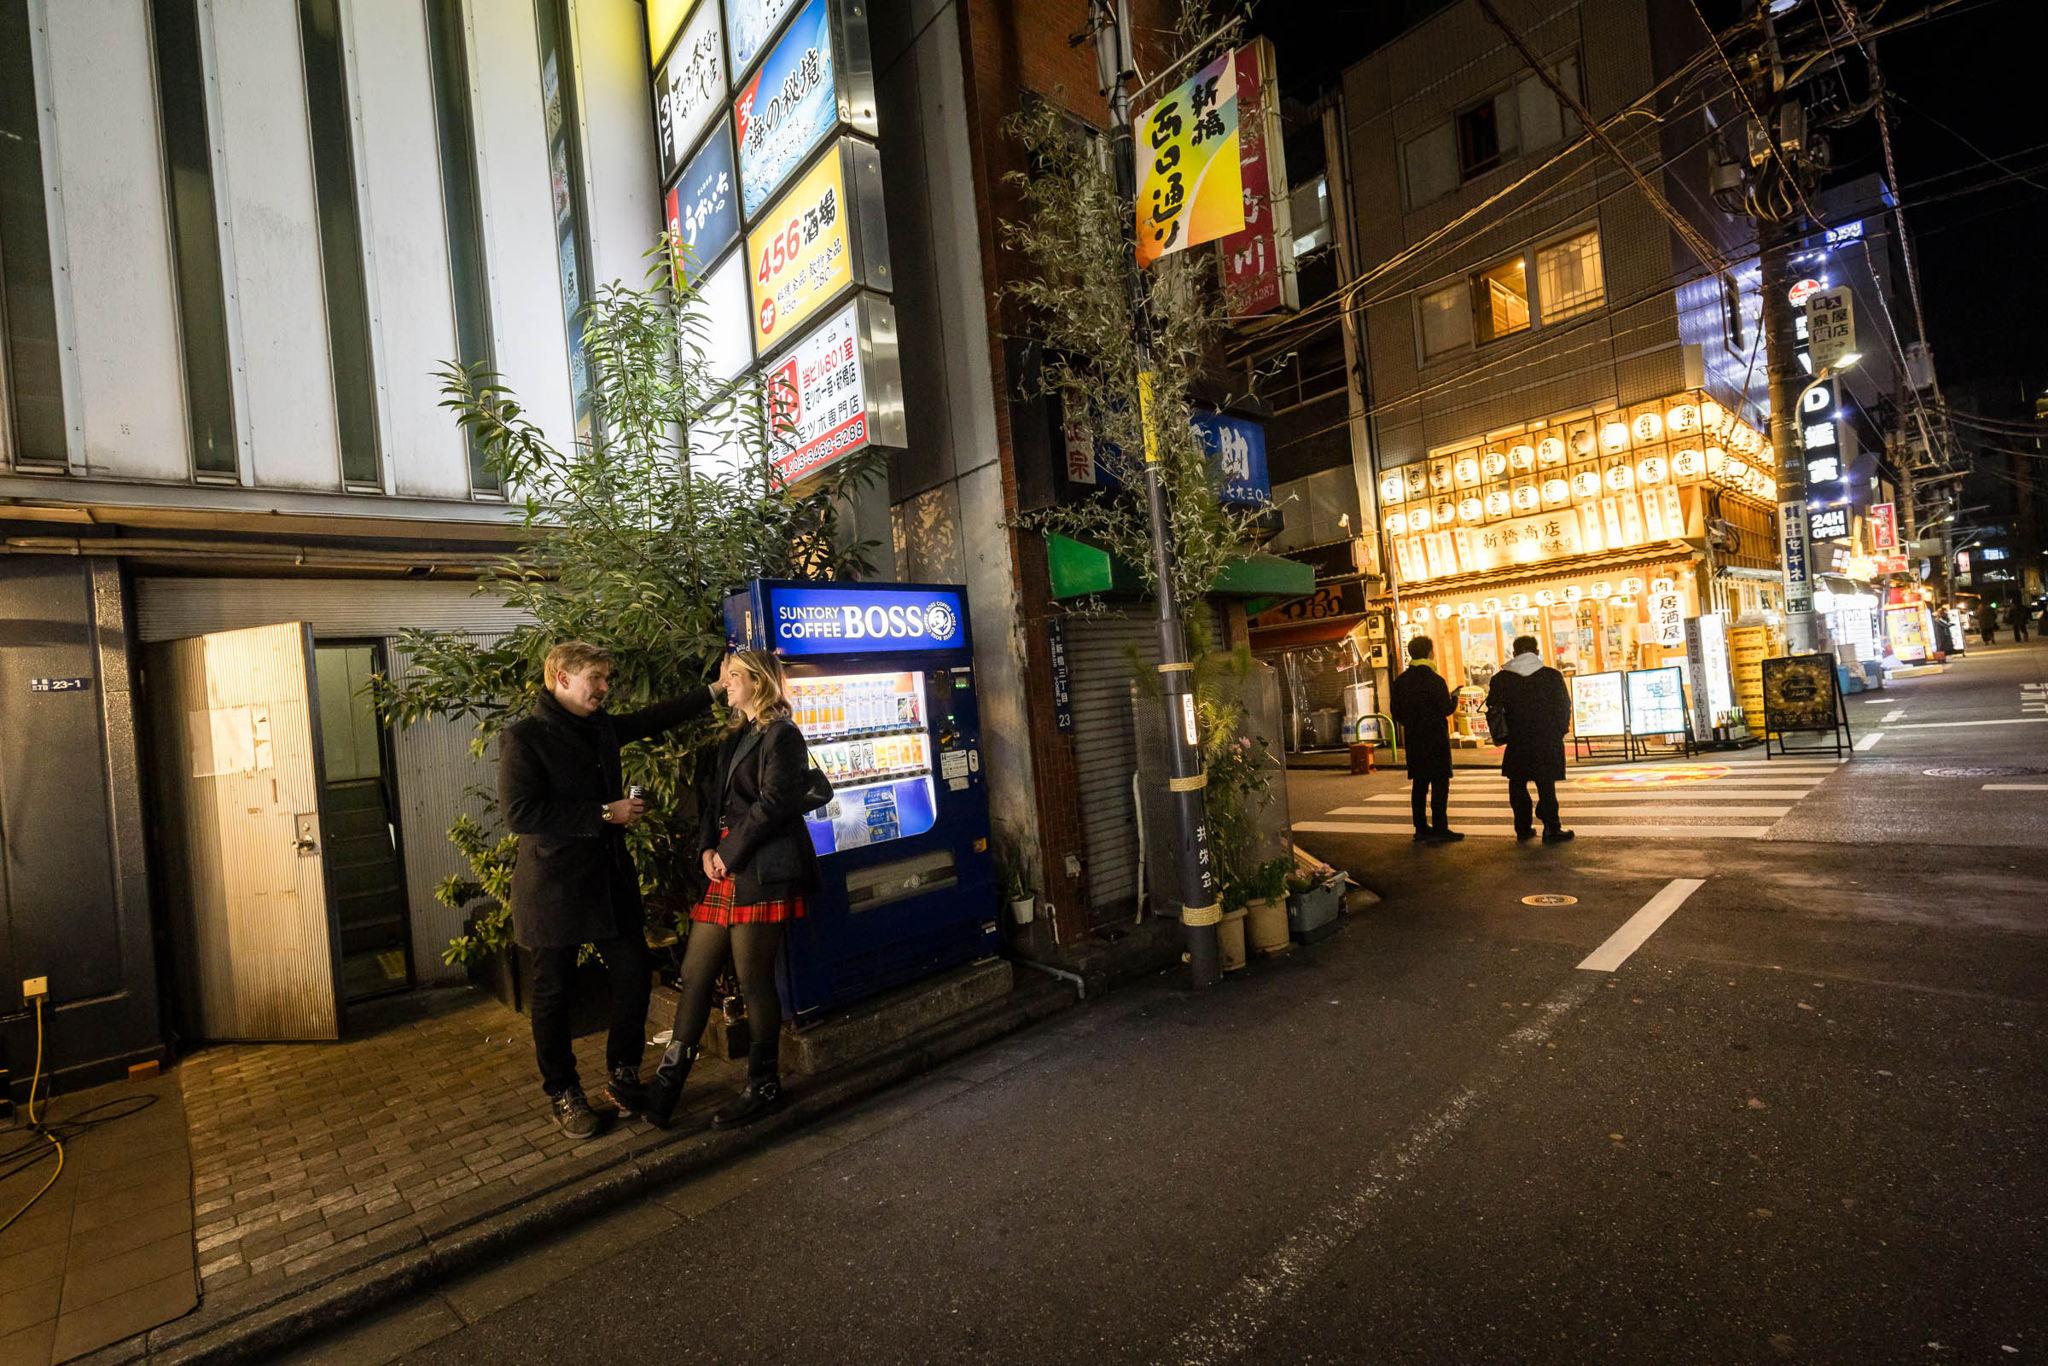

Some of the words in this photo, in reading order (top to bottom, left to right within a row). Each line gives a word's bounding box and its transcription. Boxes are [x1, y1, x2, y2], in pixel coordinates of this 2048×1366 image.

[747, 49, 822, 156] 海の秘境
[1191, 75, 1226, 147] 新橋
[1151, 101, 1184, 249] 西口通り
[760, 306, 775, 329] 2F
[1811, 510, 1844, 528] 24H
[1812, 525, 1846, 540] OPEN
[779, 606, 841, 621] SUNTORY
[842, 605, 924, 640] BOSS
[1659, 595, 1682, 641] 居酒屋
[780, 622, 842, 639] COFFEE
[52, 679, 81, 690] 23-1
[1058, 714, 1073, 728] 23
